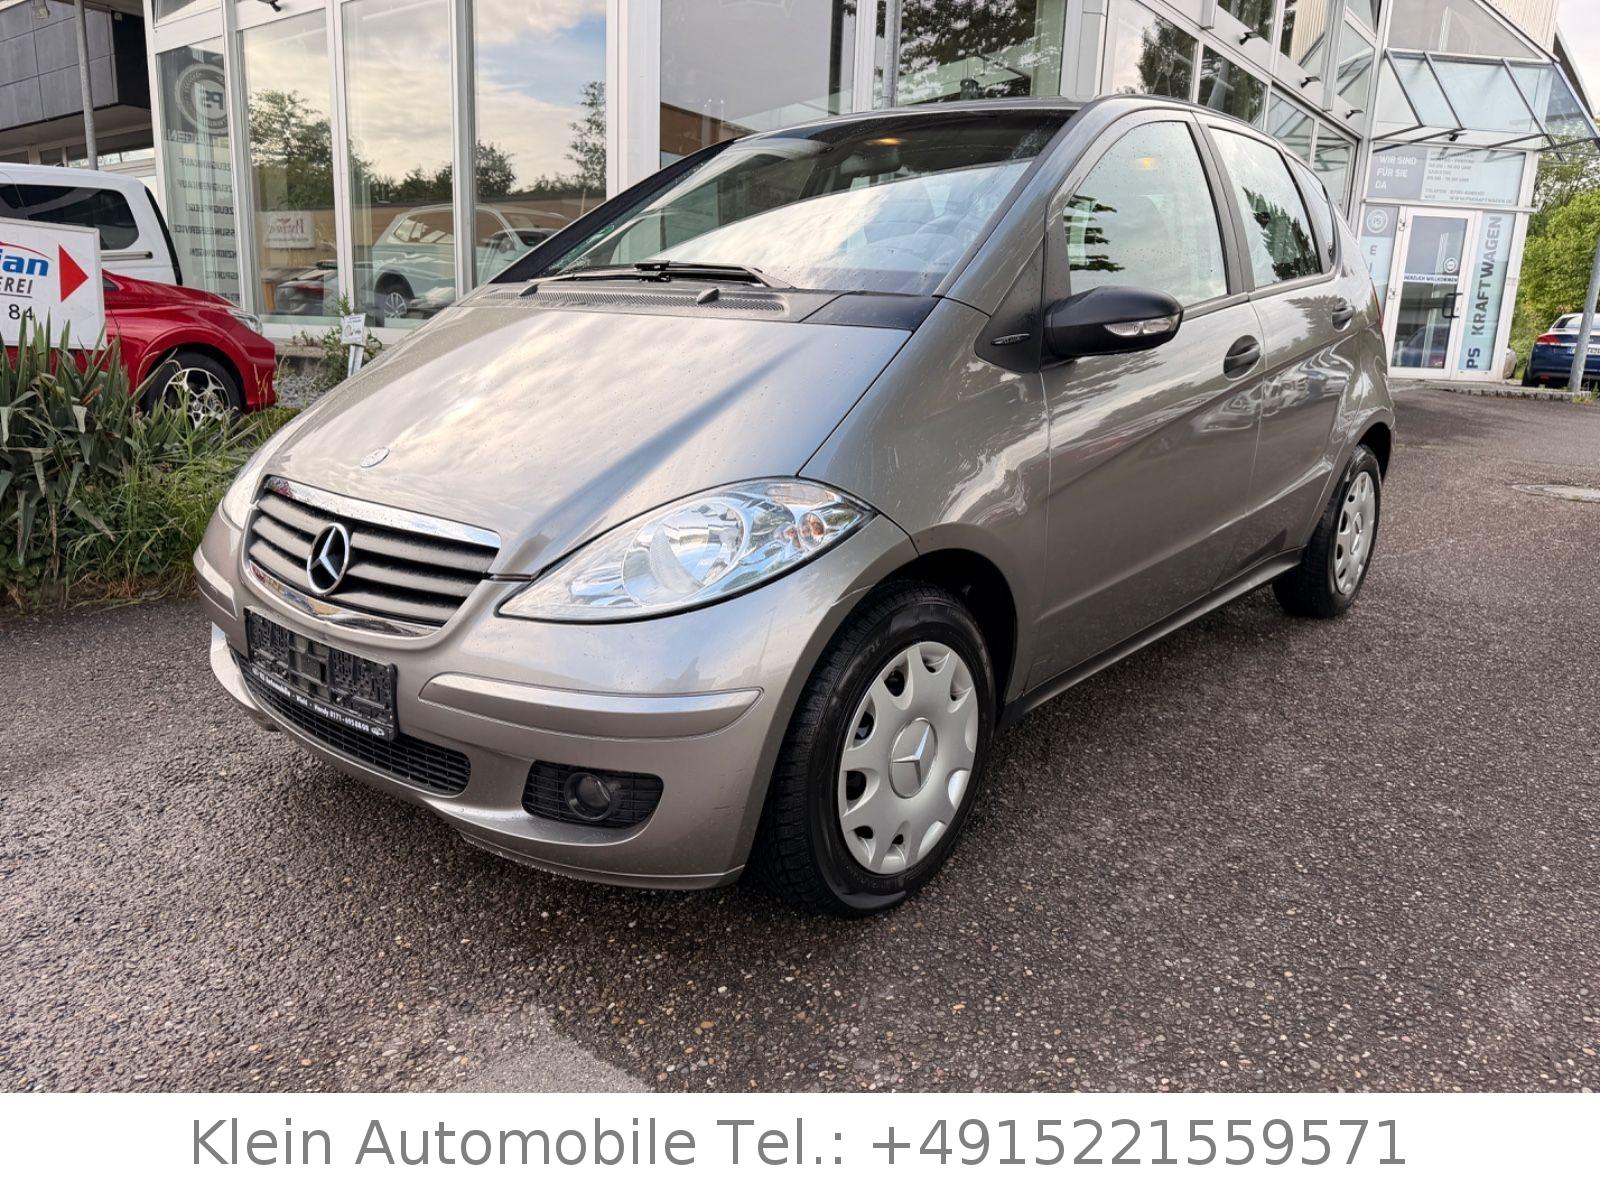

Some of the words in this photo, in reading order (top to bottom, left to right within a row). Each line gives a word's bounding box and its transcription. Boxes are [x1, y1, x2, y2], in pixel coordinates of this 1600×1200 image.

[1379, 156, 1396, 165] WIR
[1397, 157, 1417, 166] SIND
[1376, 167, 1394, 177] FÜR
[1395, 168, 1409, 178] SIE
[1375, 180, 1387, 189] DA
[1471, 216, 1503, 336] KRAFTWAGEN
[9, 303, 33, 321] 84
[1466, 347, 1481, 369] PS
